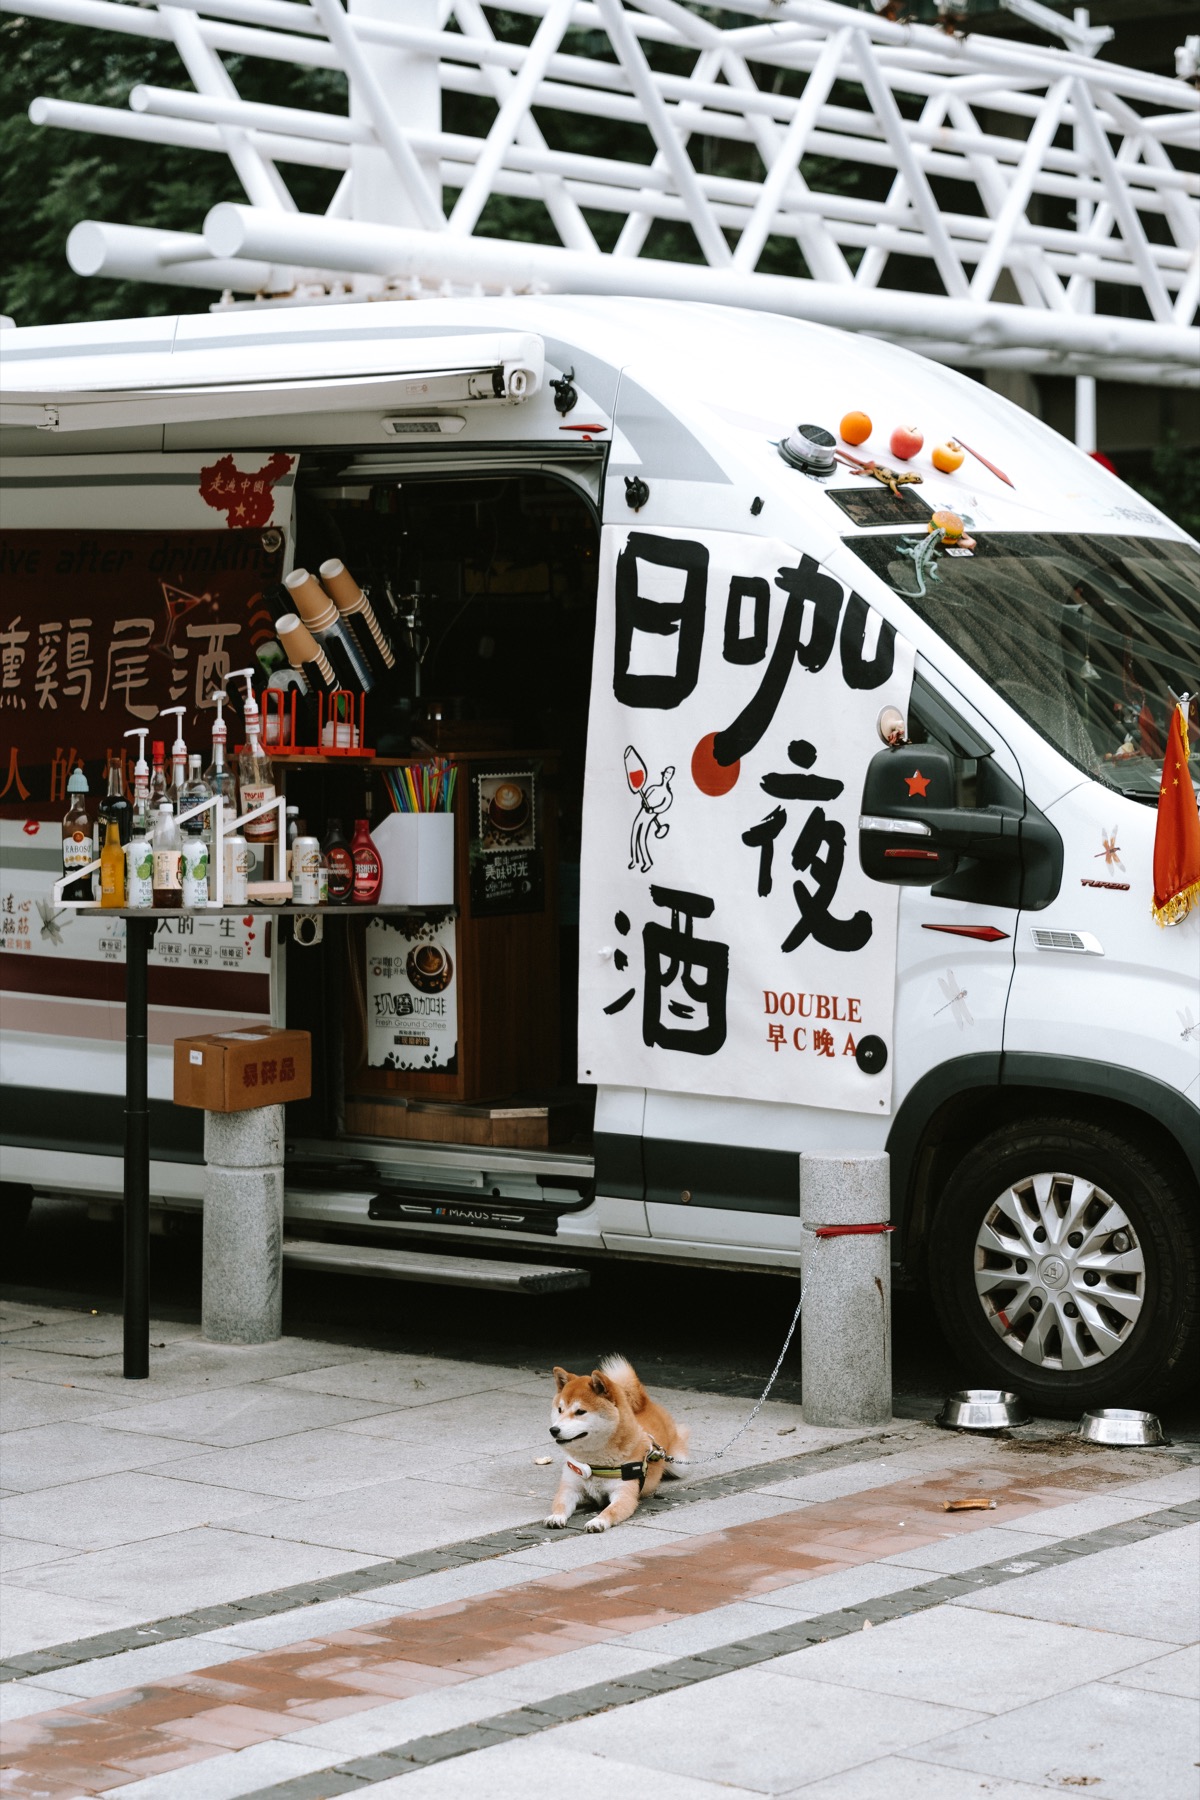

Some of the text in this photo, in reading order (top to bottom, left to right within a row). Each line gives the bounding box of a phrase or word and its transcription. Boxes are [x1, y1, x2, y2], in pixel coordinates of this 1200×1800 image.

[1080, 878, 1131, 891] TURBO
[373, 992, 447, 1017] 现磨咖啡
[762, 990, 862, 1023] DOUBLE
[375, 1018, 447, 1029] Fresh Ground Coffee
[449, 1208, 490, 1220] MAXUS
